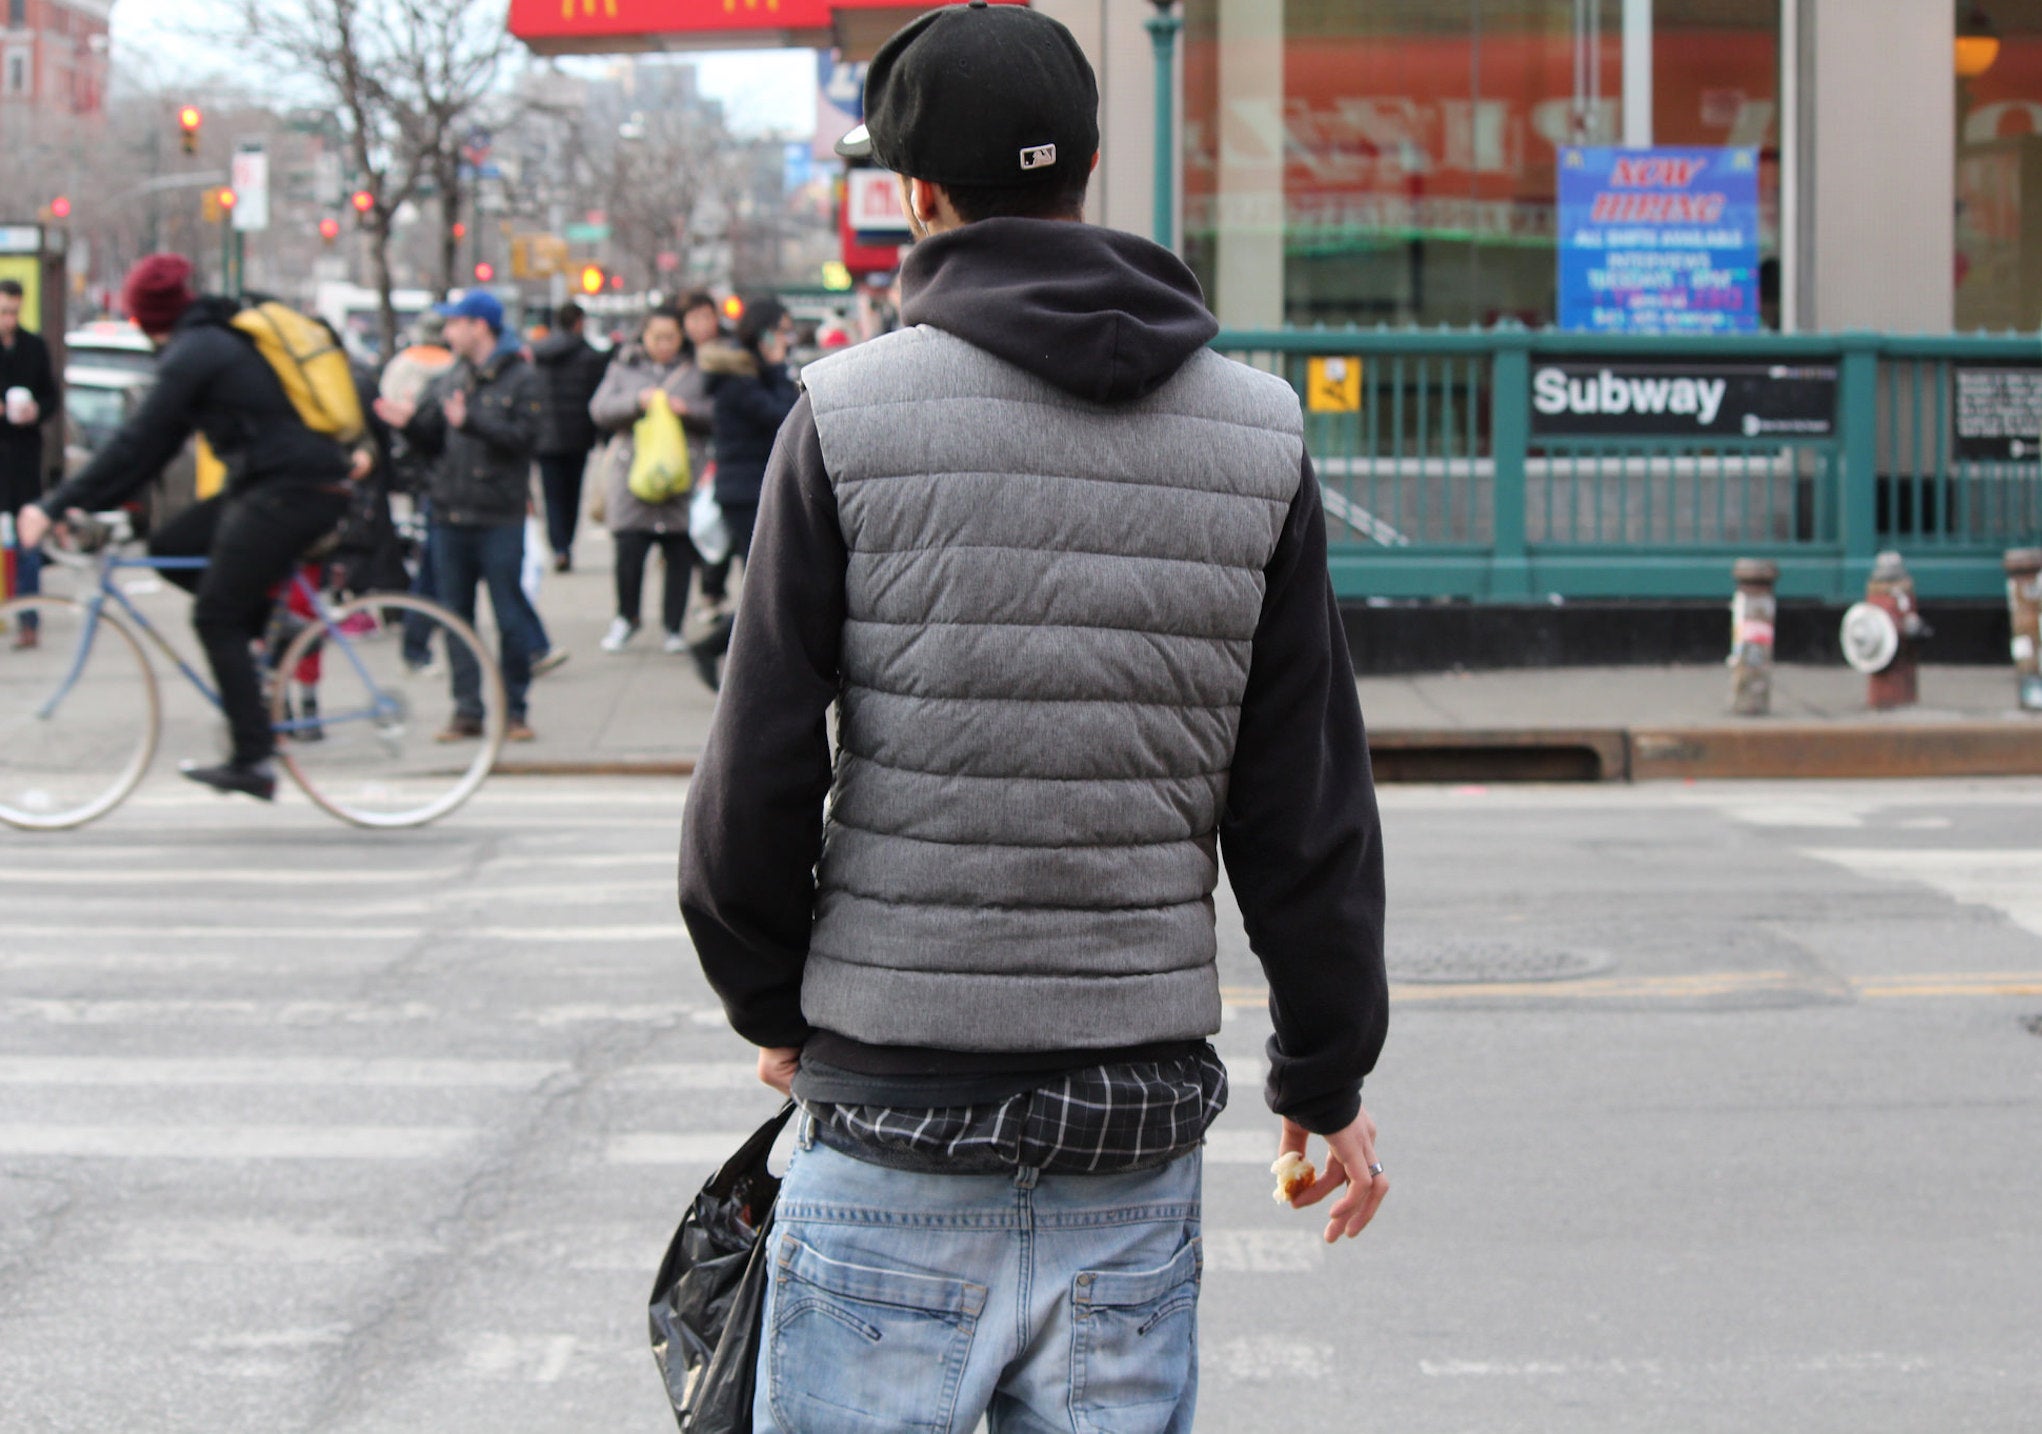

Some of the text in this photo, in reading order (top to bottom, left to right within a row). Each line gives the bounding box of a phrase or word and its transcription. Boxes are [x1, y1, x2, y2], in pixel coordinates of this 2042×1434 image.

[1610, 157, 1708, 188] NOW
[1590, 192, 1727, 223] HIRING
[1533, 366, 1726, 425] Subway
